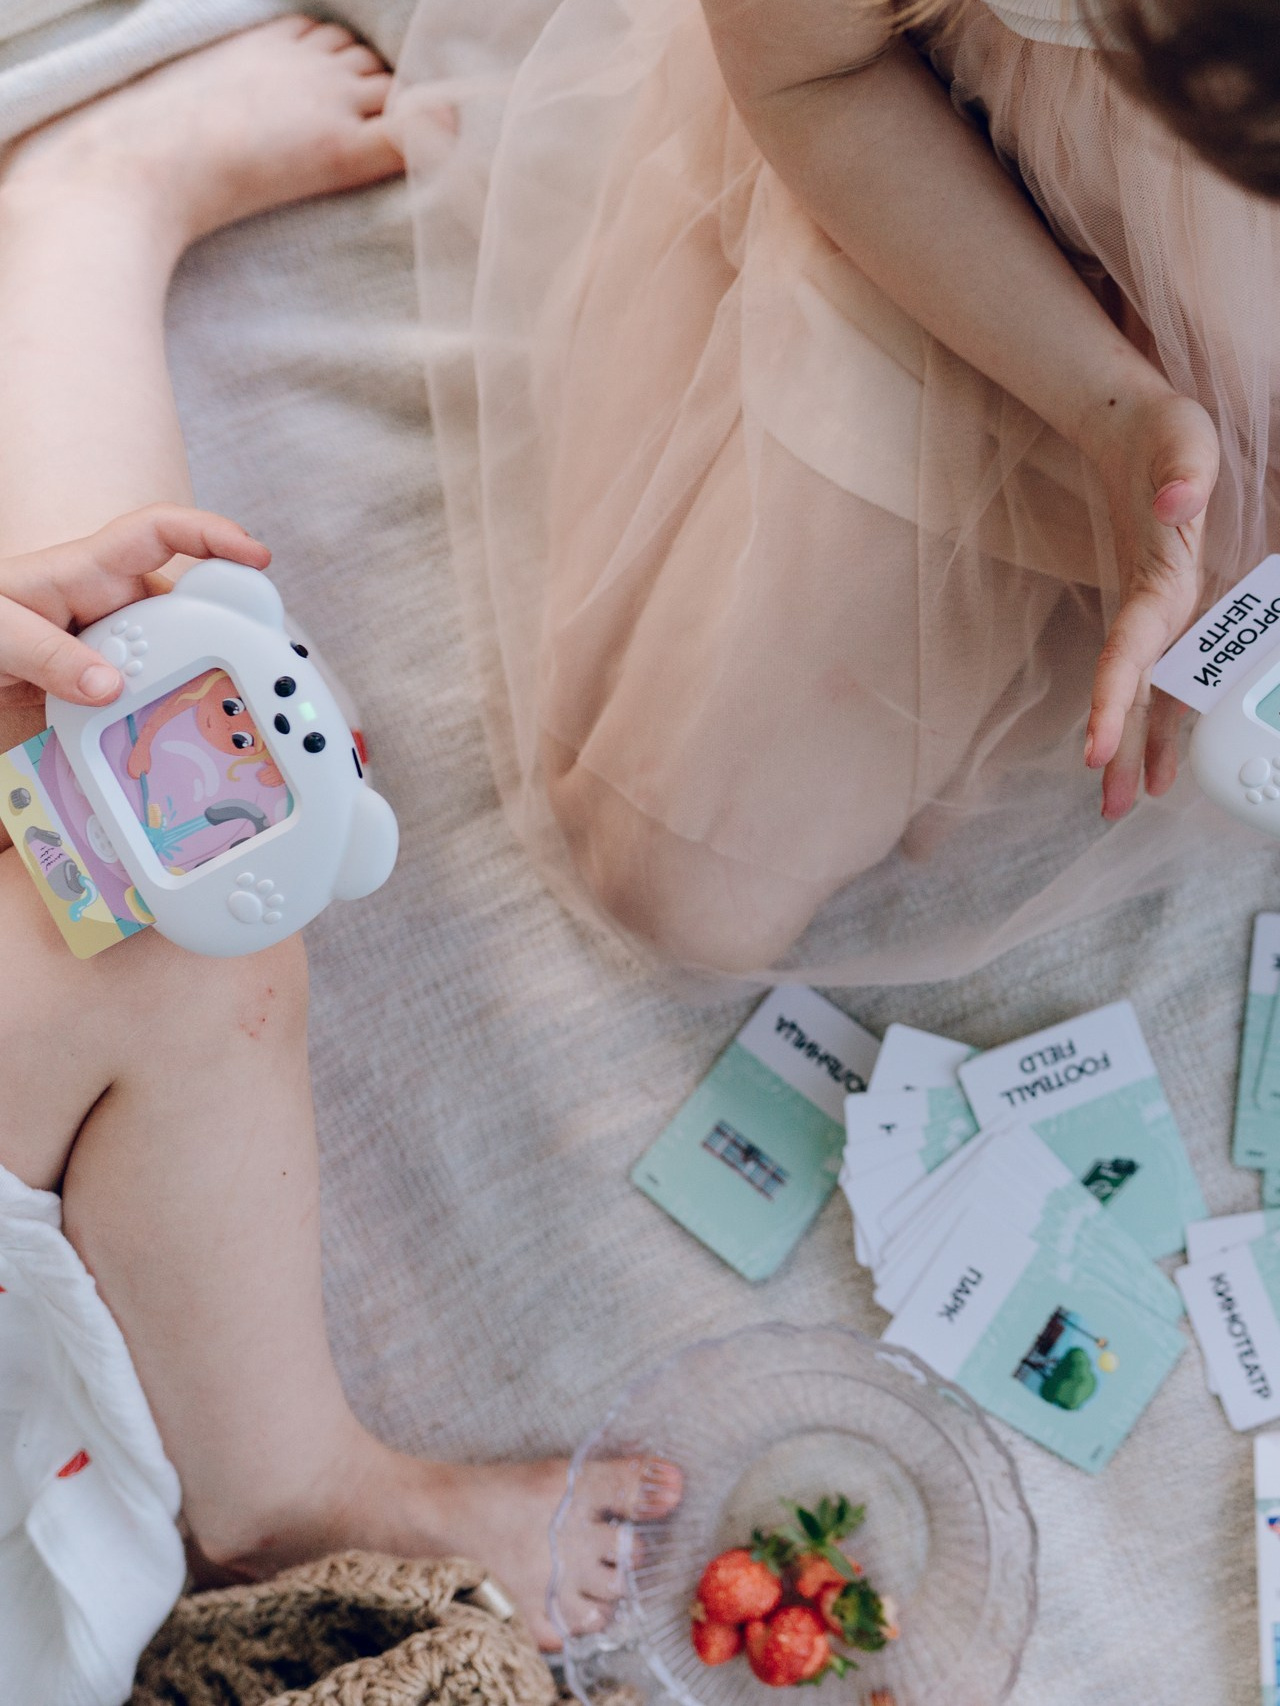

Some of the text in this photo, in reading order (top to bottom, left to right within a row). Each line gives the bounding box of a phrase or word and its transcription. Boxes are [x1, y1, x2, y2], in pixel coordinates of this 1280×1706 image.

[1199, 593, 1261, 653] ЦЕНТР
[999, 1051, 1111, 1107] FOOTBALL
[1019, 1039, 1077, 1074] FIELD
[938, 1266, 984, 1322] ПАРК
[1209, 1272, 1272, 1400] КИНОТЕАТР
